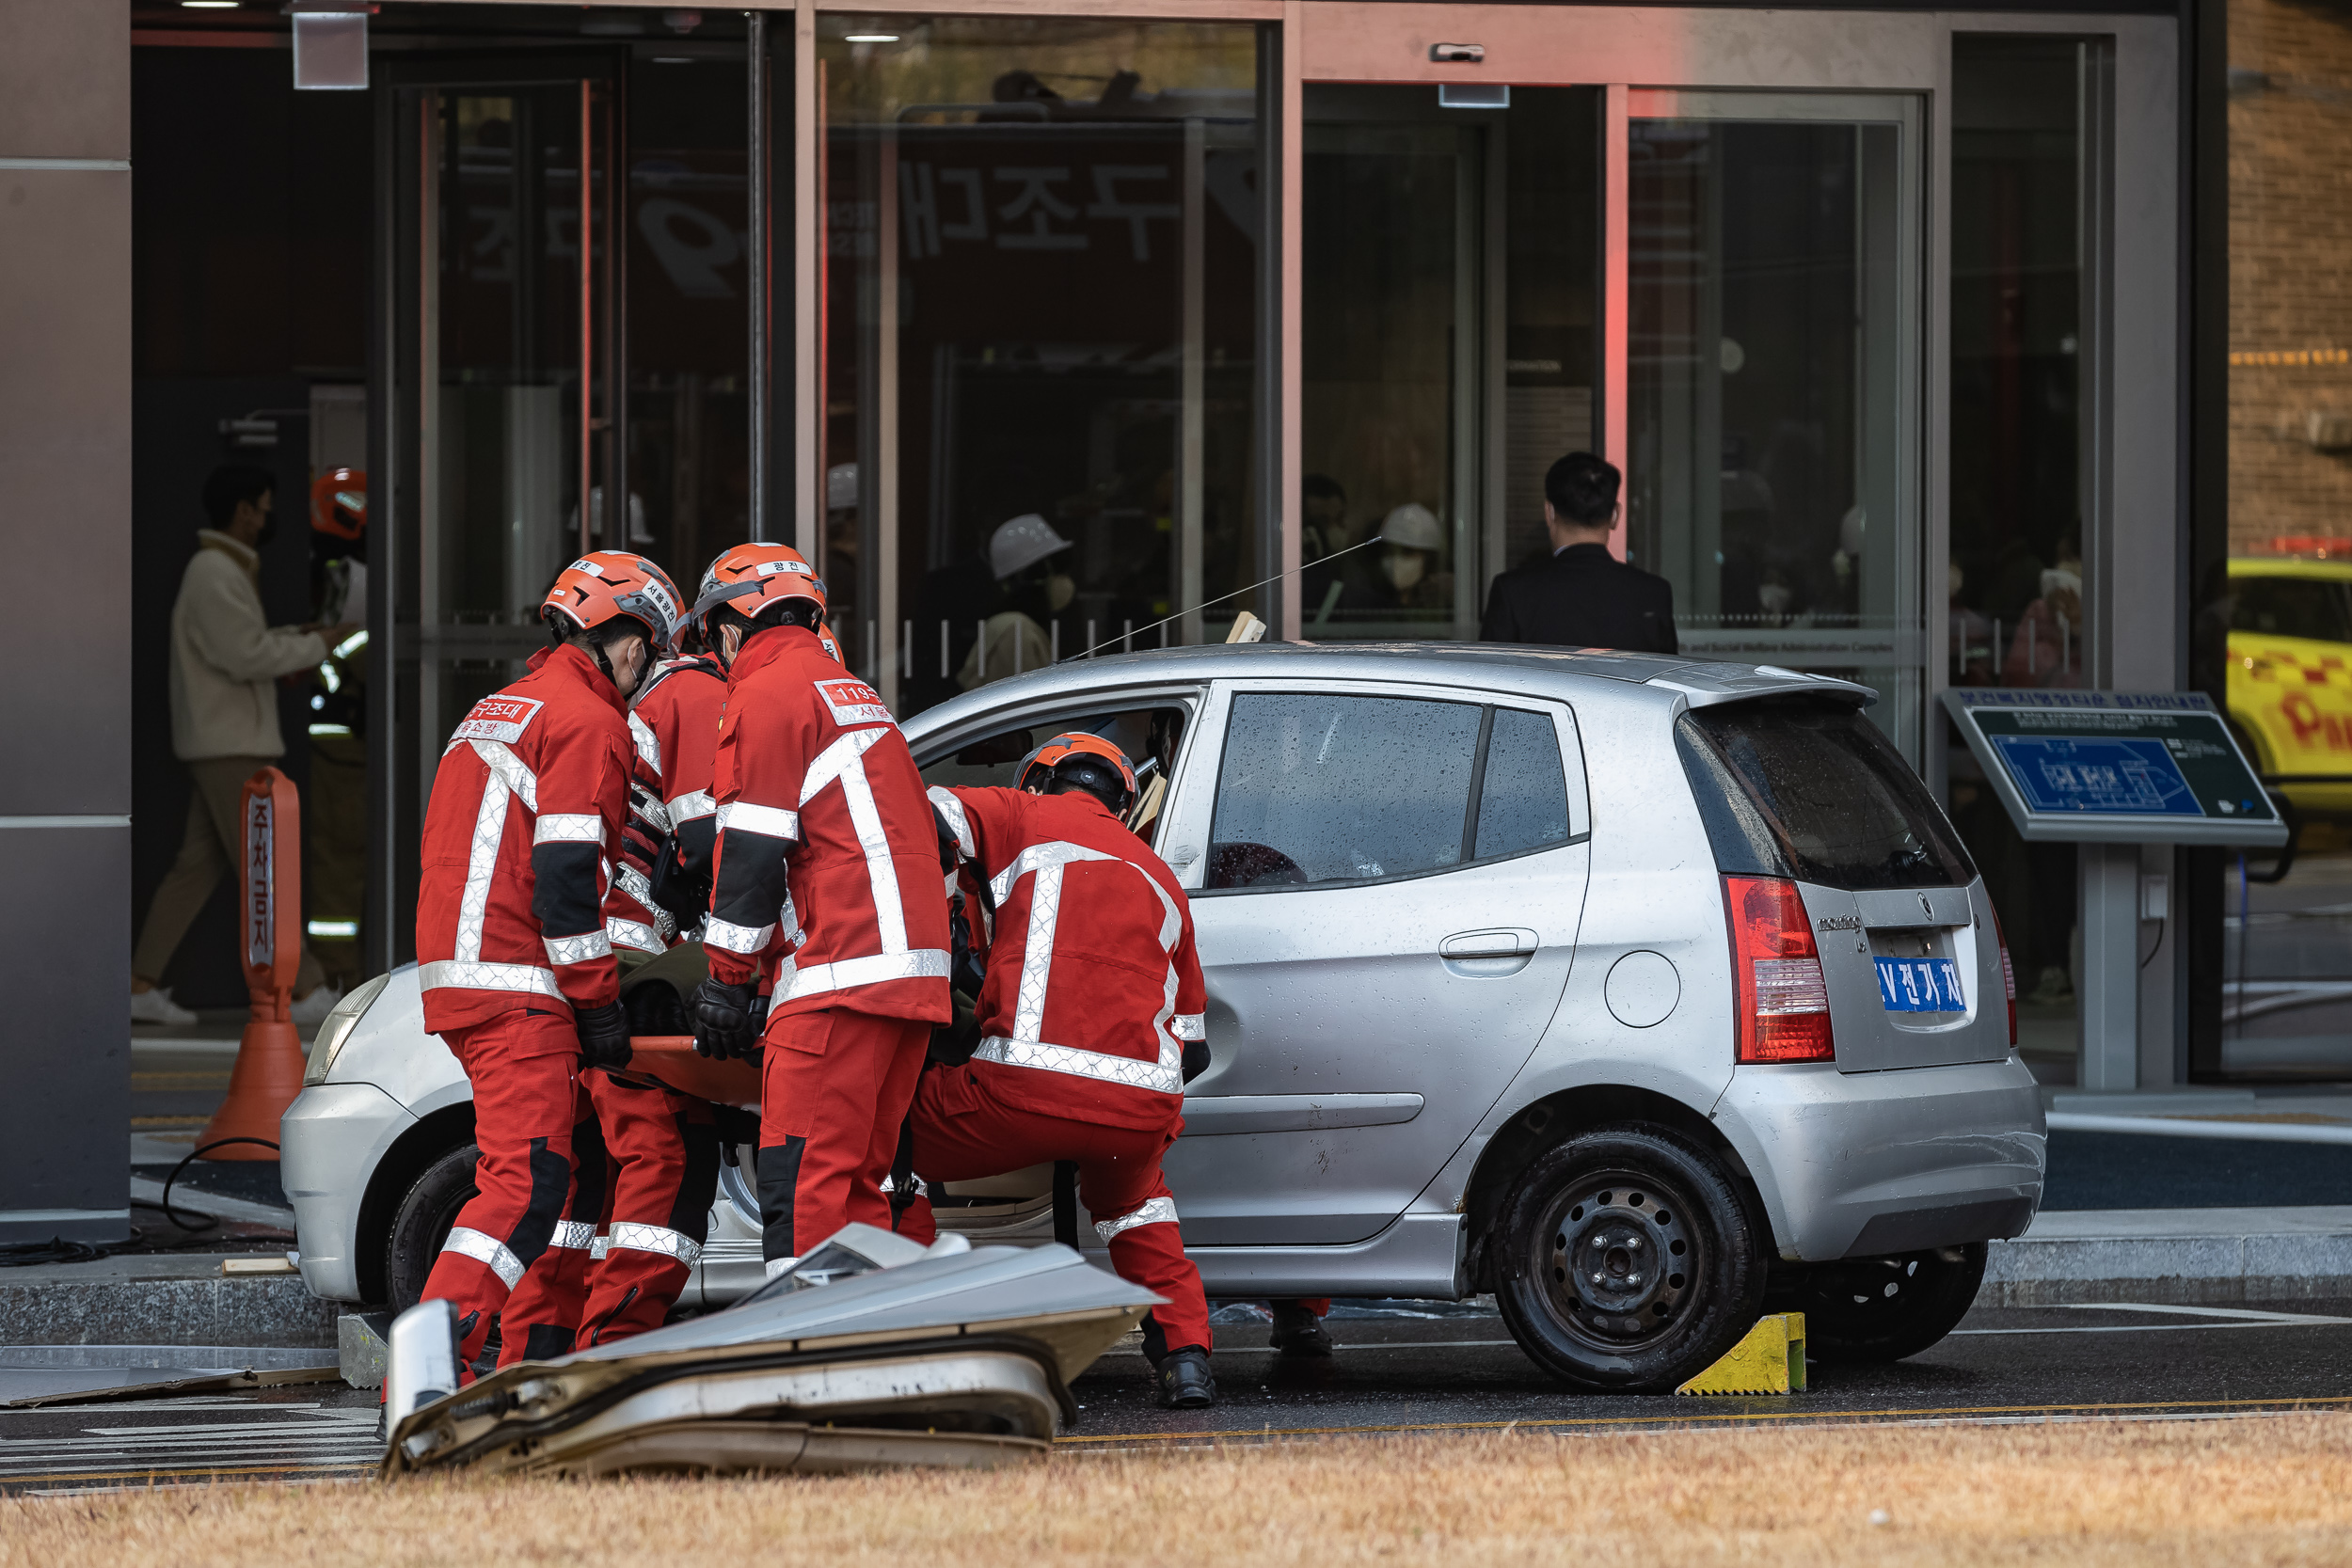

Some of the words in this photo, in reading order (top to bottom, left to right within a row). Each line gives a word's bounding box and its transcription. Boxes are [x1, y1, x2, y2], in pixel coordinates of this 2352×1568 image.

[773, 562, 800, 572] 광진
[647, 585, 675, 622] 서울광진
[455, 721, 498, 735] 울소방
[253, 805, 268, 954] 주차금지
